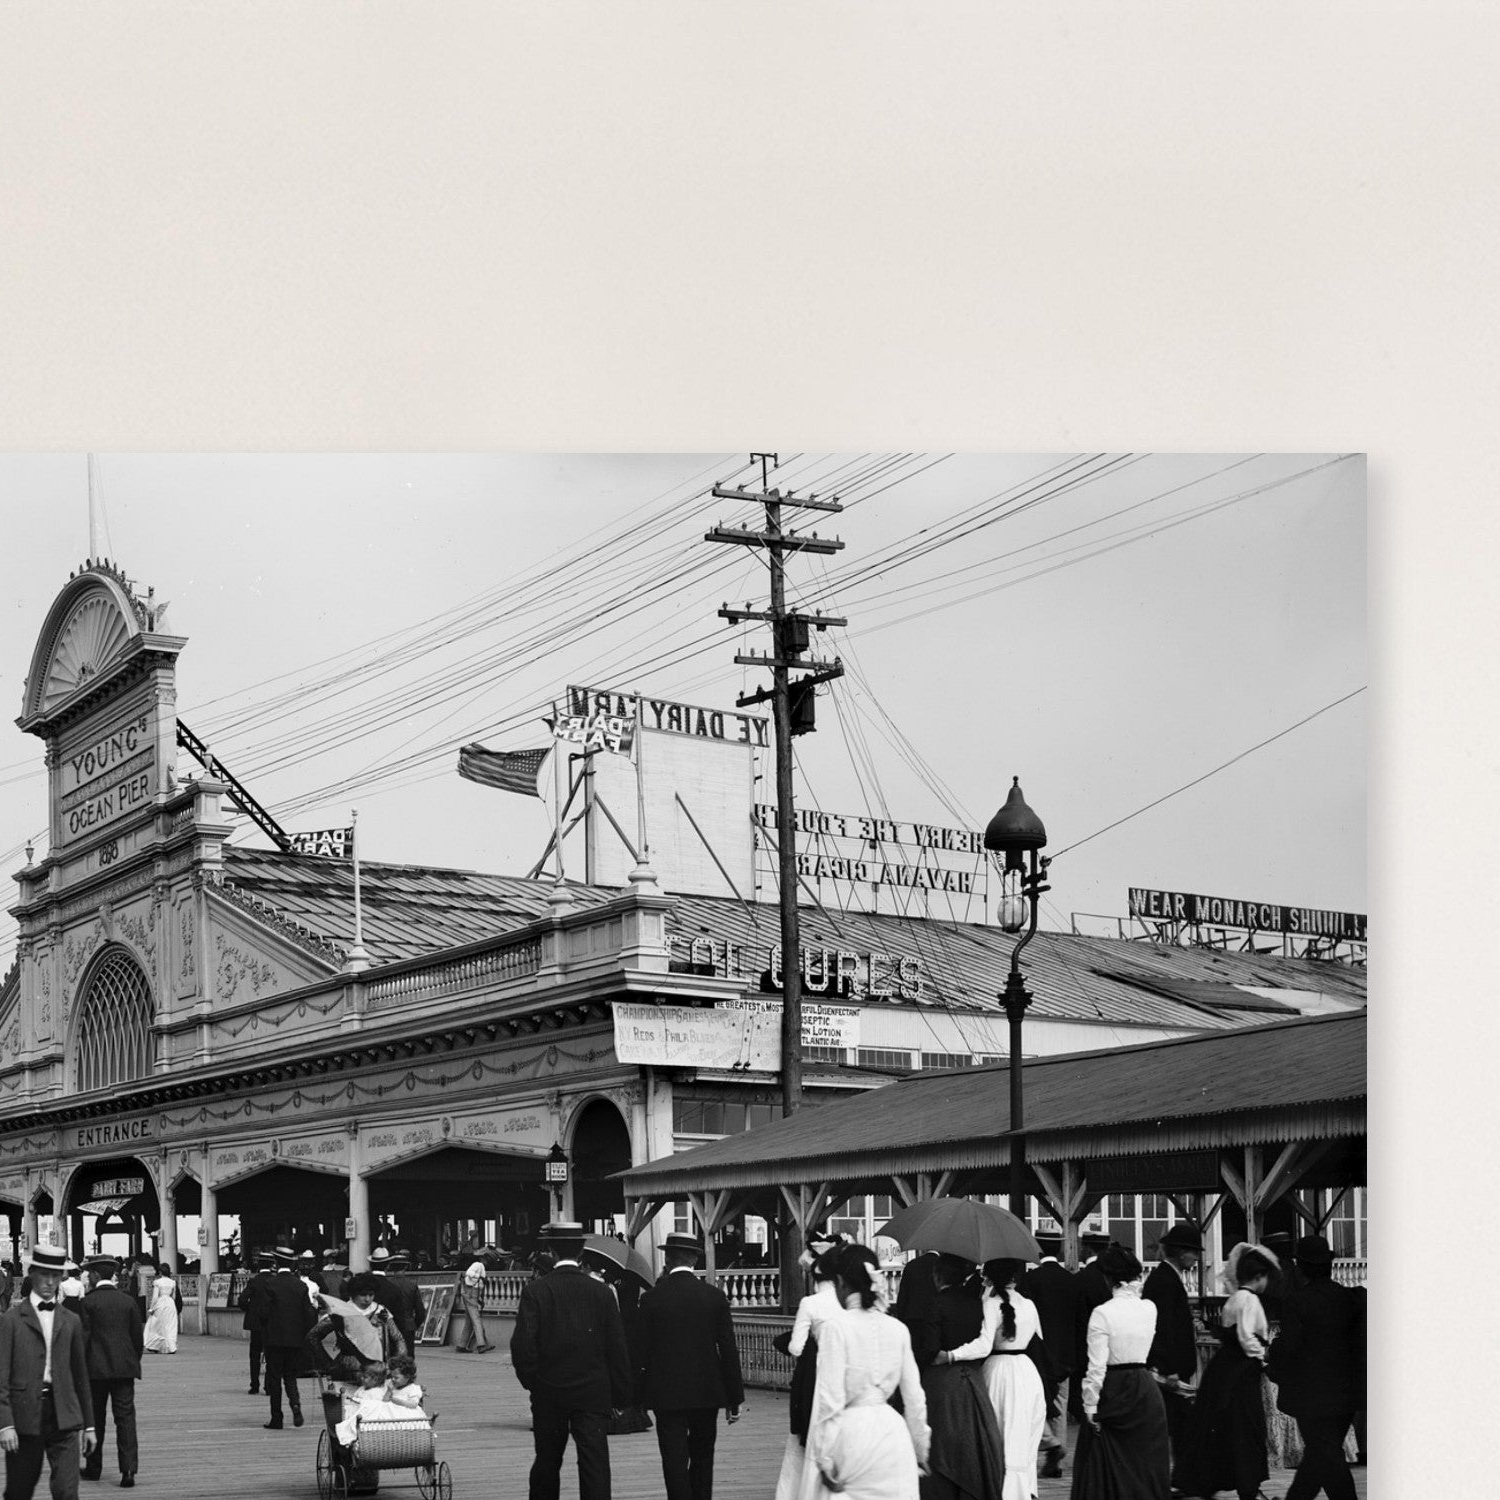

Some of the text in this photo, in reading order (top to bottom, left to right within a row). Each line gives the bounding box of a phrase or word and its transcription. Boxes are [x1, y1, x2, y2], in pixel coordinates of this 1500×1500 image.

[69, 773, 150, 834] OCEAN PIER
[98, 840, 119, 867] 1898
[1131, 888, 1186, 919] WEAR
[1194, 896, 1281, 930] MONARCH
[616, 1005, 677, 1021] CHAMPIONSHIP
[801, 1015, 830, 1026] SEPTIC
[633, 1026, 655, 1042] REDS
[812, 1025, 842, 1038] LOTION
[801, 1036, 830, 1046] TLANTIC
